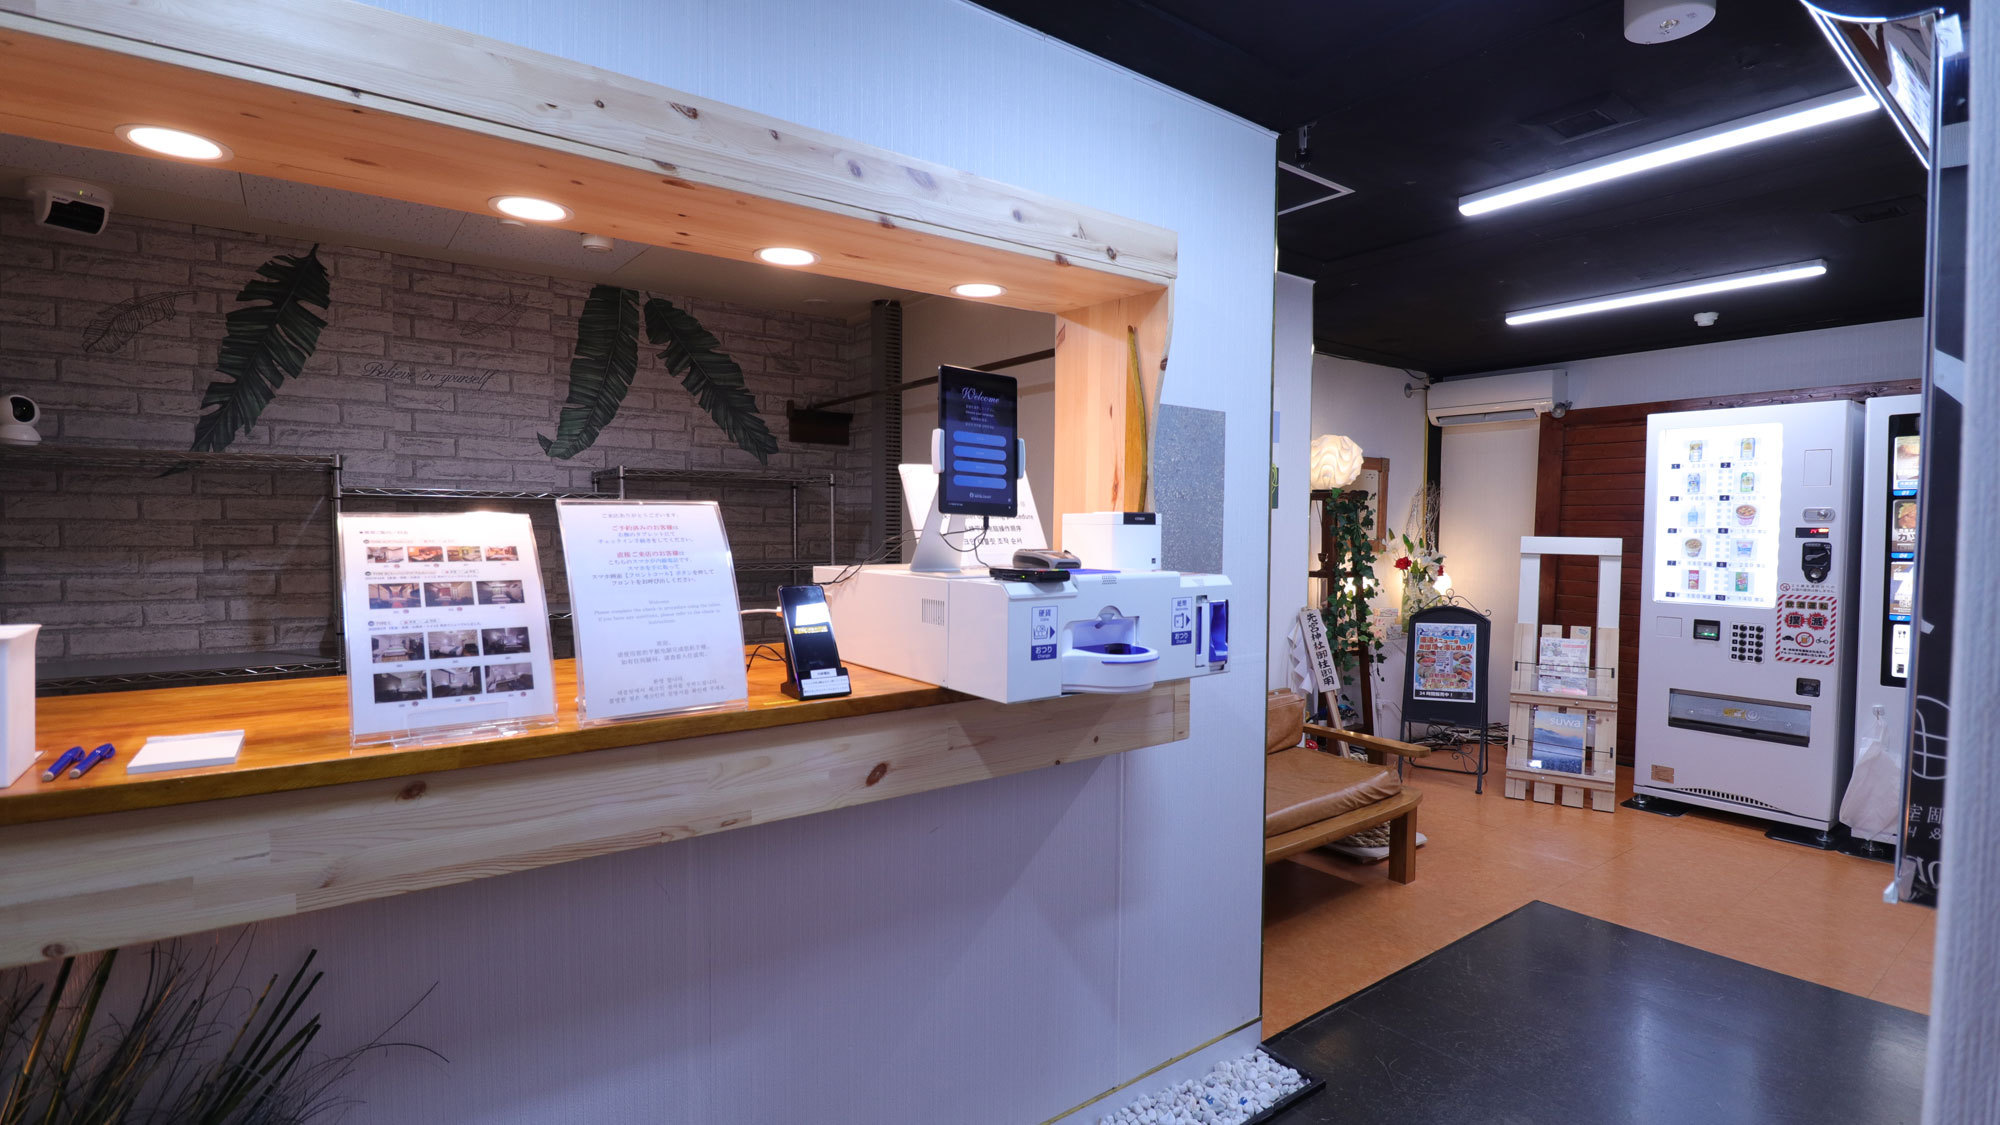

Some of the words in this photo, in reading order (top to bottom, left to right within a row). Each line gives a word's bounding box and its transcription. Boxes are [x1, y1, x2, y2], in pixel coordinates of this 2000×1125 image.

[362, 362, 411, 379] Believe
[422, 369, 435, 380] in
[434, 369, 499, 391] yourself
[961, 387, 1000, 403] Welcome
[1035, 646, 1053, 654] おつり
[1550, 716, 1581, 729] suwa
